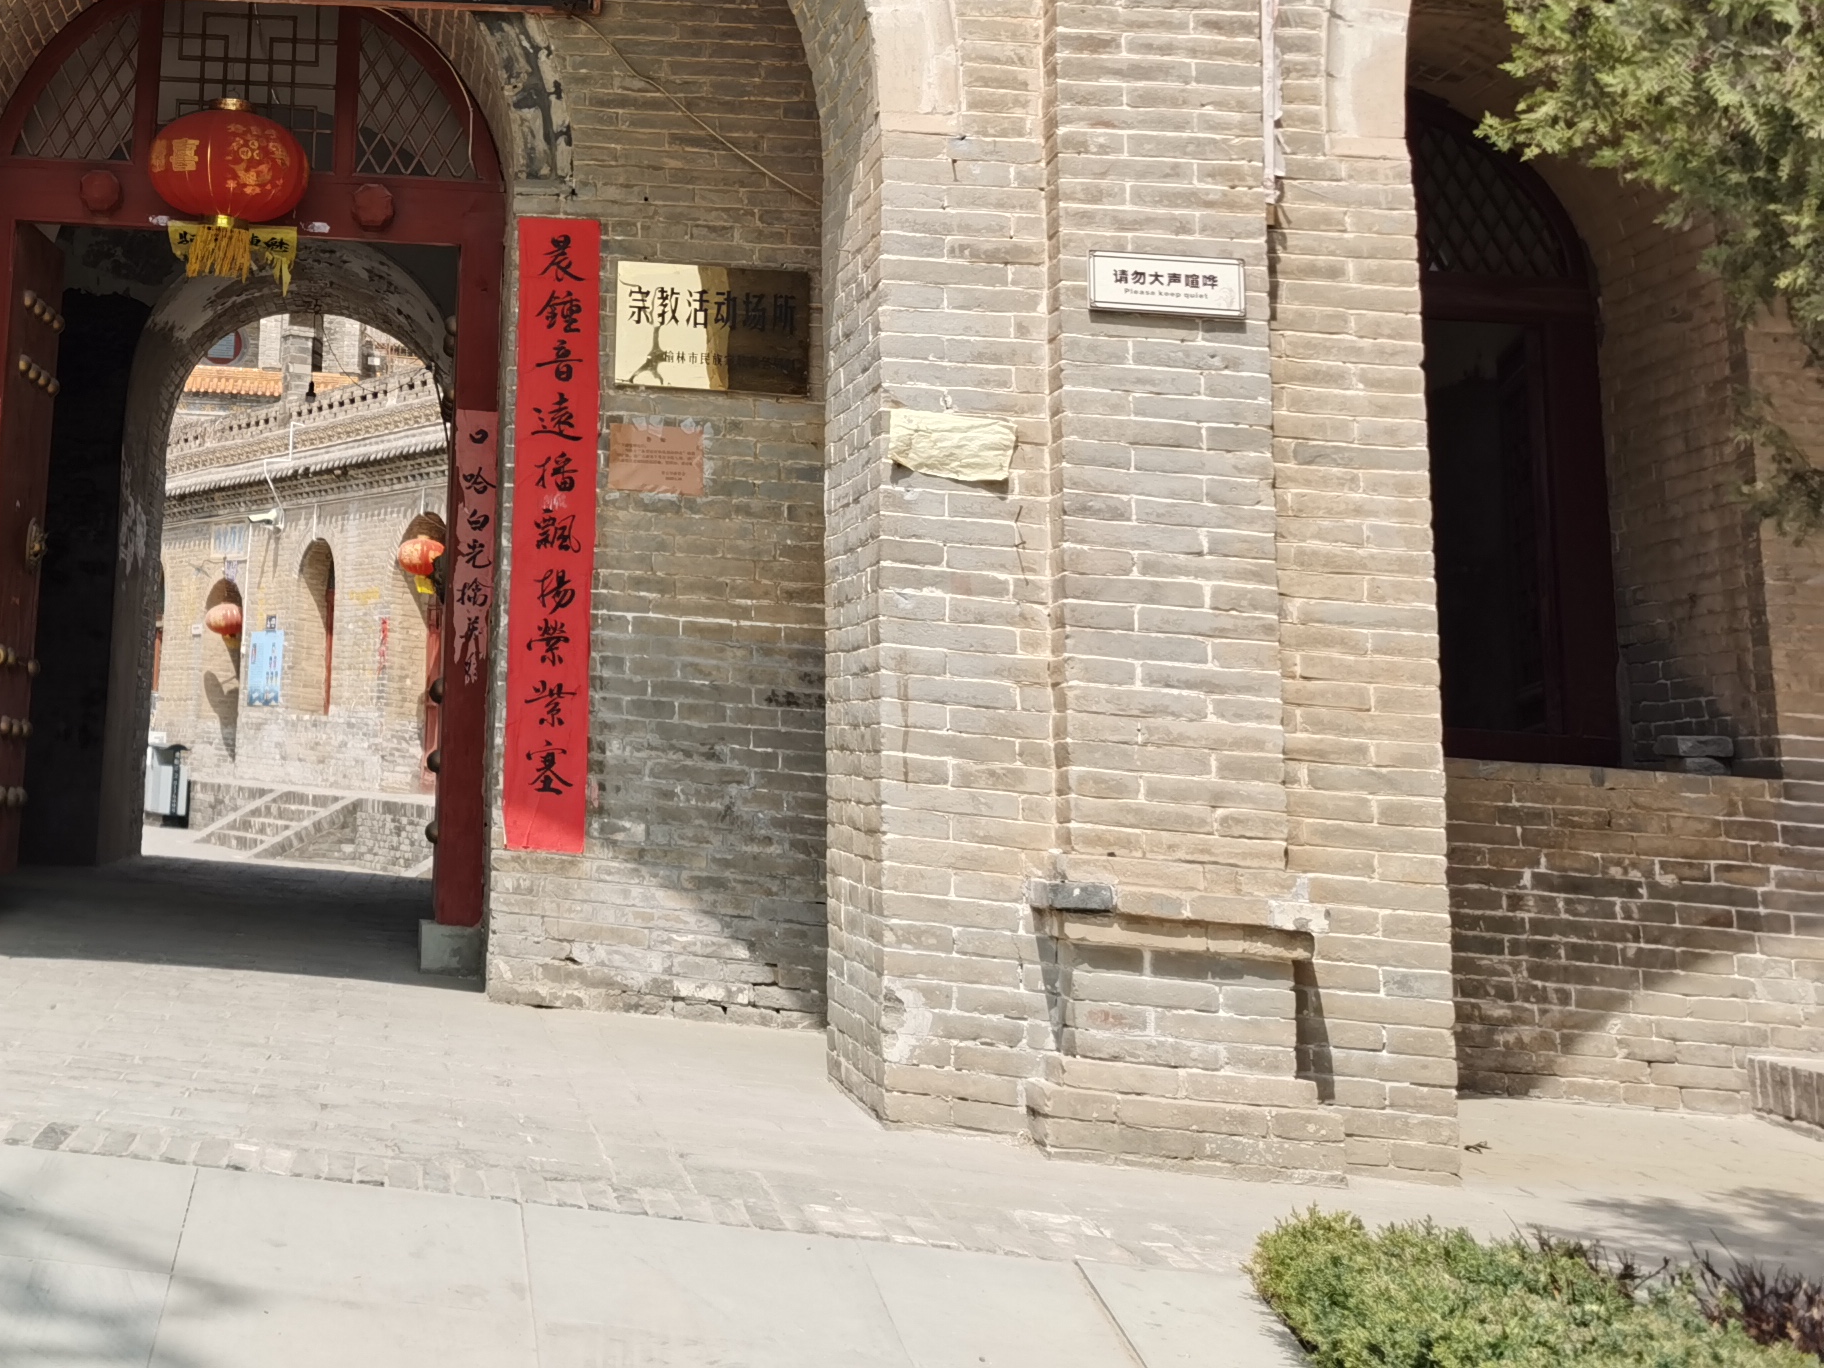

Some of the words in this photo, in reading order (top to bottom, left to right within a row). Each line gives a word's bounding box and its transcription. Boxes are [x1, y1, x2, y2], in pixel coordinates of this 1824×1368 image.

[1112, 268, 1219, 290] 请勿大声喧哗
[1123, 287, 1156, 296] Please
[1158, 289, 1182, 299] keep
[1183, 291, 1209, 300] quiet
[627, 285, 797, 334] 宗教活动场所
